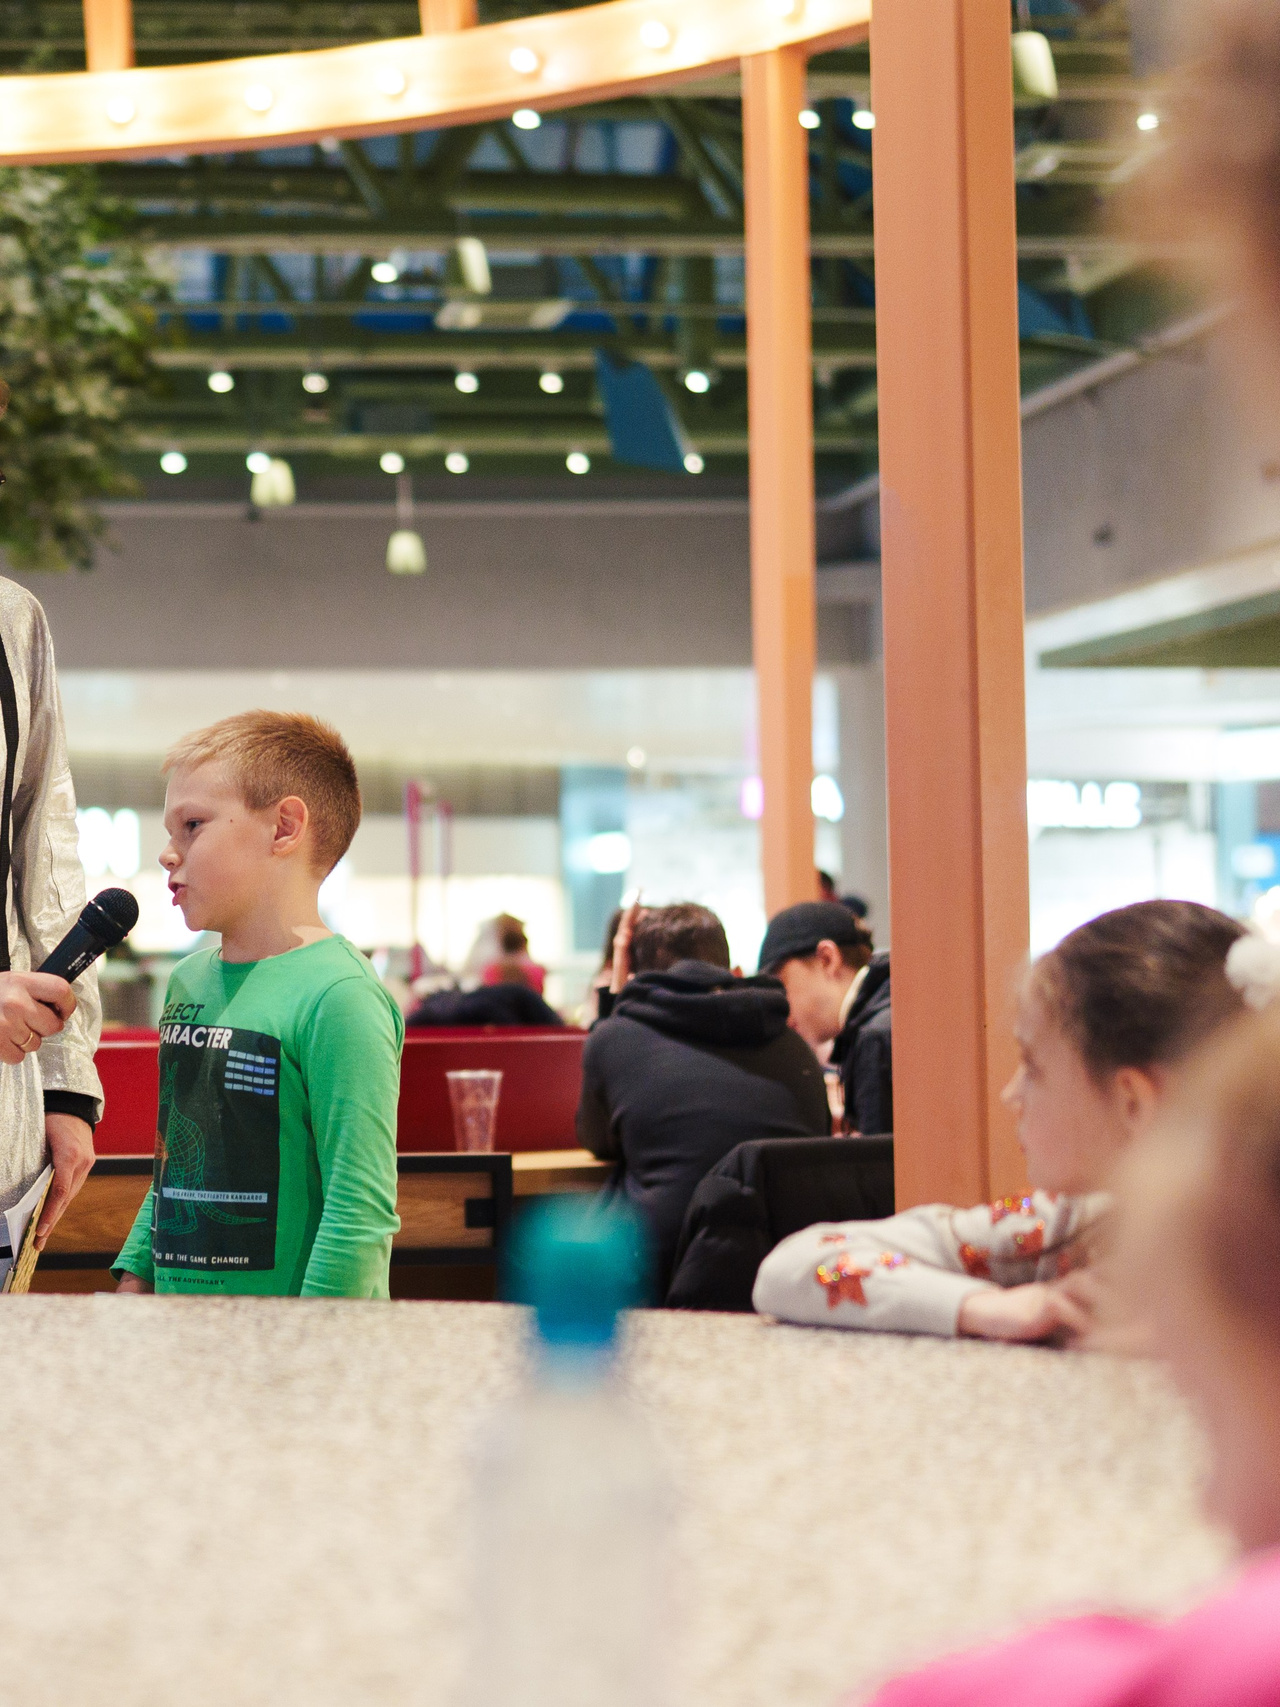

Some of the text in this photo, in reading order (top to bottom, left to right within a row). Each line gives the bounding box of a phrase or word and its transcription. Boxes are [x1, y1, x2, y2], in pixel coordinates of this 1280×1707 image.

[162, 1003, 205, 1022] ELECT
[160, 1024, 233, 1050] HARACTER
[165, 1252, 174, 1260] BE
[177, 1253, 187, 1262] THE
[190, 1255, 207, 1264] GAME
[211, 1256, 249, 1264] CHANGER
